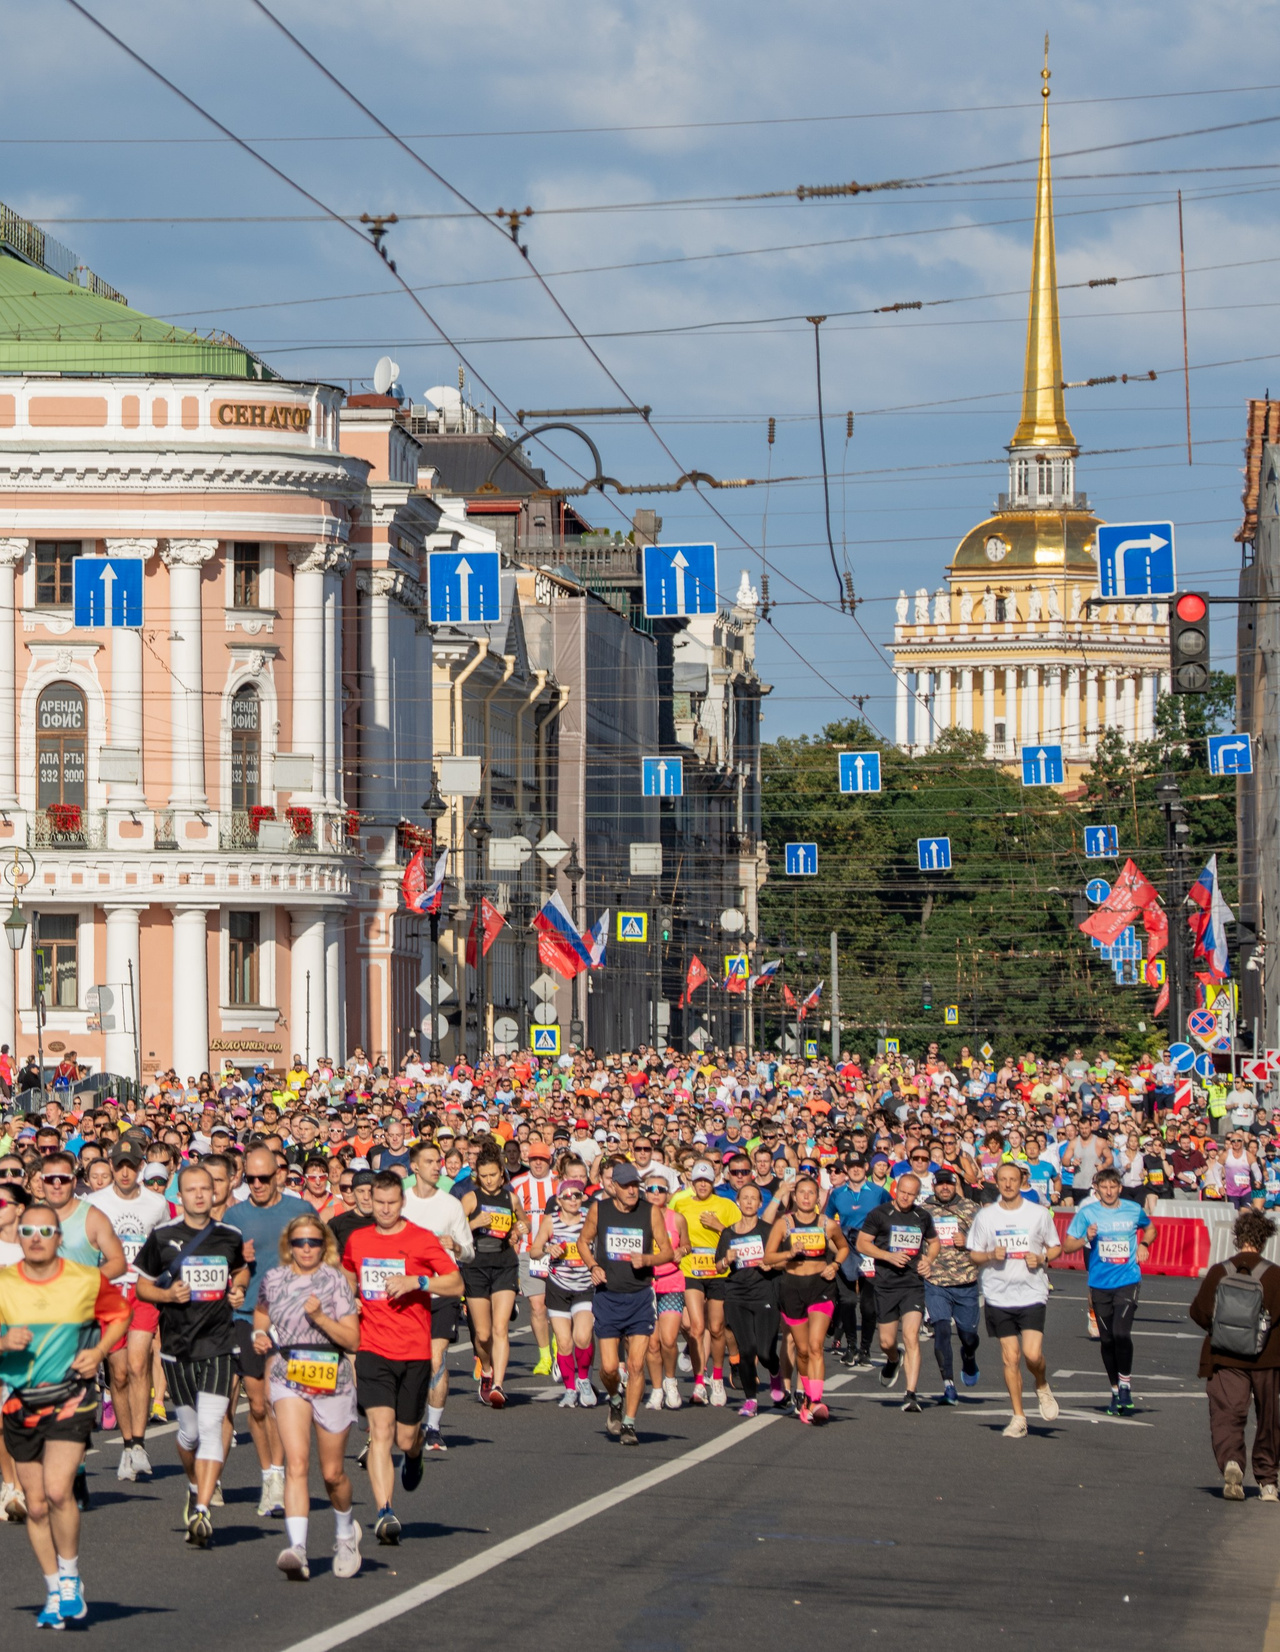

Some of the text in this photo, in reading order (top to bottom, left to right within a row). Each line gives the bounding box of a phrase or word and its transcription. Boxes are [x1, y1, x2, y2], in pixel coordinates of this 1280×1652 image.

[218, 404, 311, 429] СЕНАТОР
[40, 701, 83, 713] АРЕНДА
[42, 713, 81, 728] ОФИС
[41, 769, 84, 783] 332 3000
[610, 1237, 641, 1248] 13958
[893, 1233, 920, 1244] 13425
[998, 1237, 1028, 1248] 11164
[739, 1246, 763, 1257] 4932
[1101, 1243, 1128, 1252] 14256
[186, 1270, 226, 1283] 13301
[292, 1364, 335, 1380] 11318
